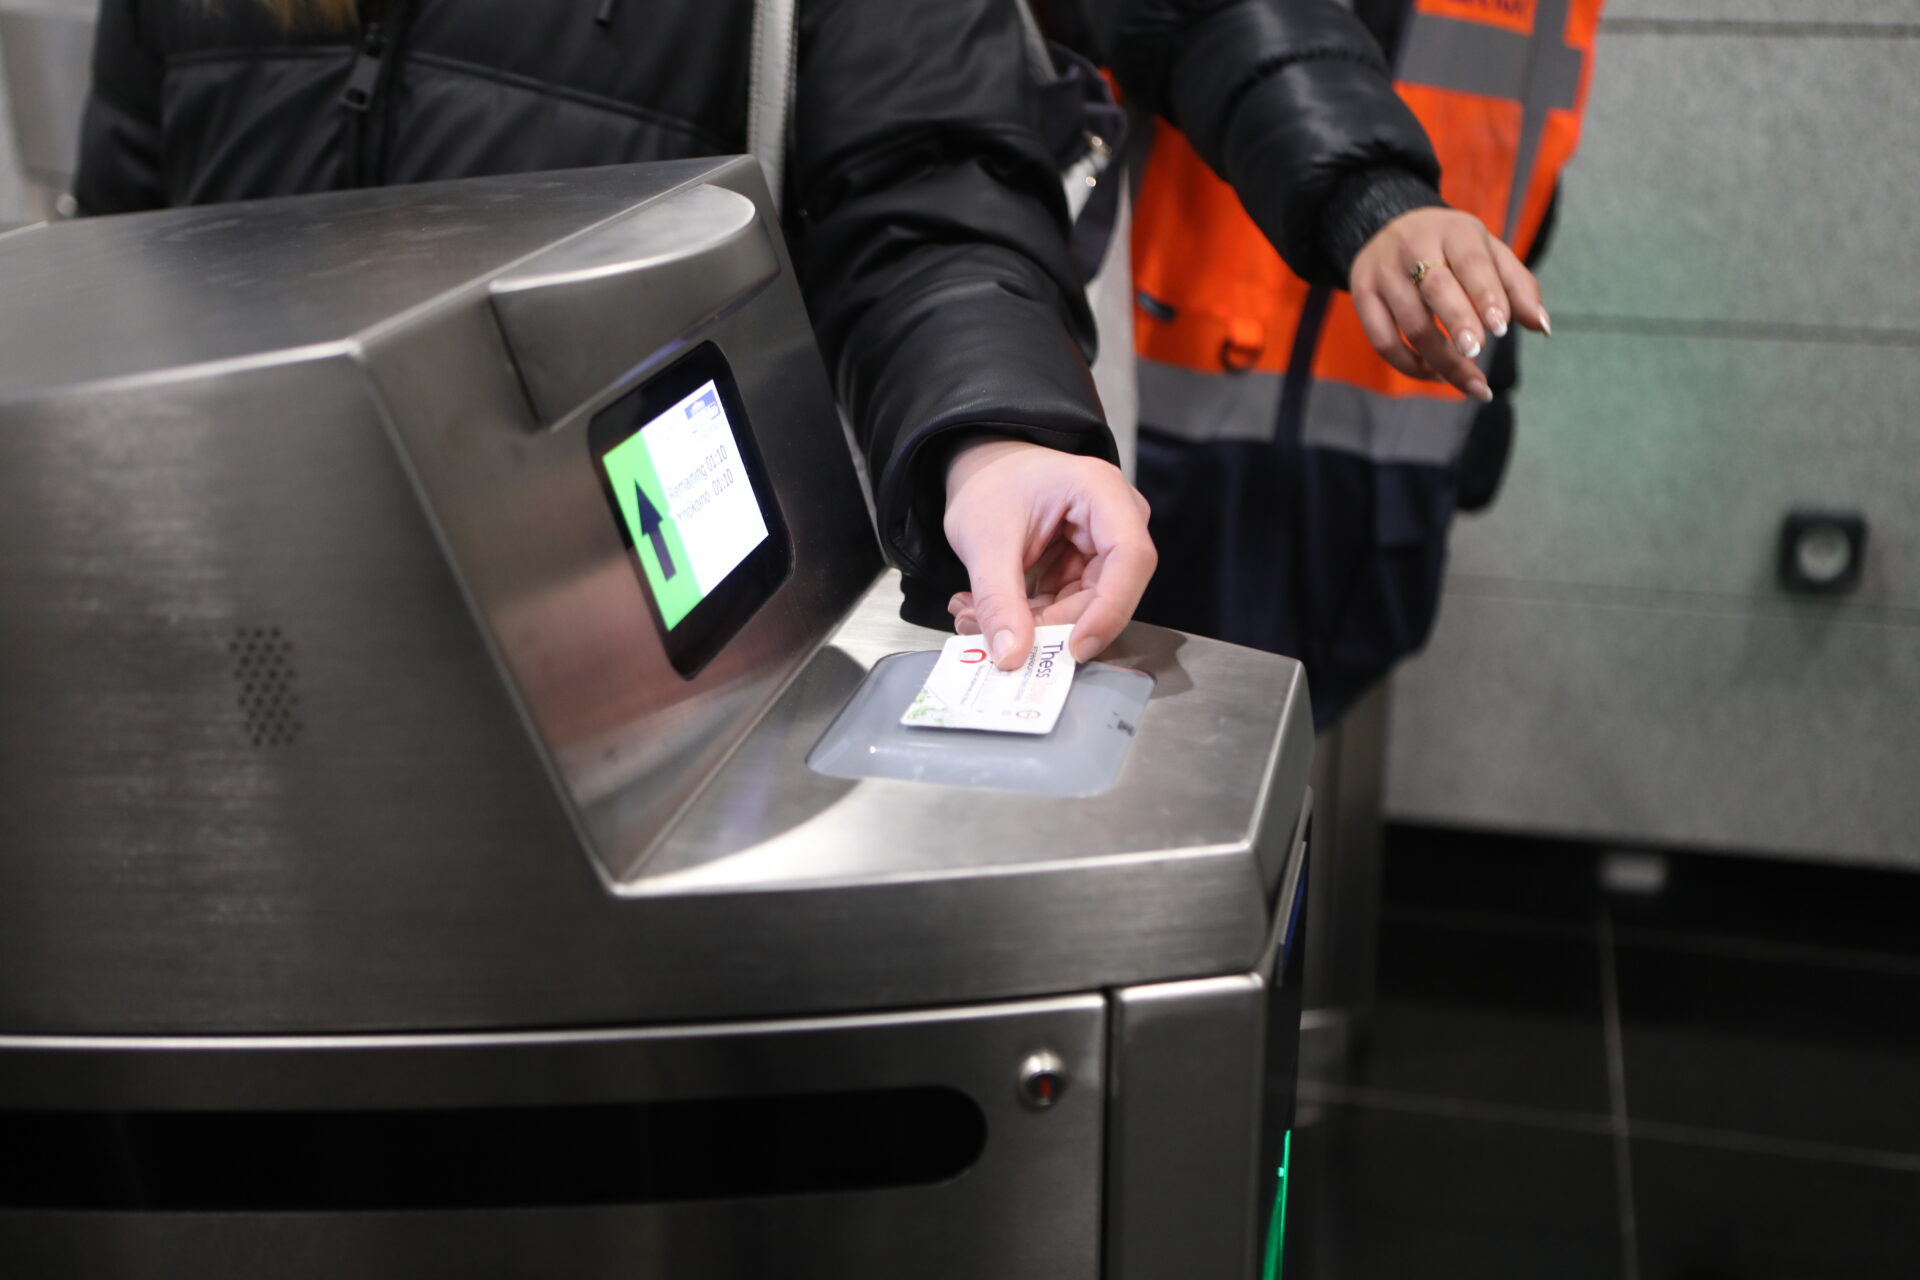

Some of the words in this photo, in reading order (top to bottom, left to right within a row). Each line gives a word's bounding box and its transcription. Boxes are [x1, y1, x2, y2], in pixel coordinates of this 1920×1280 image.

[668, 464, 708, 500] Remaining
[705, 444, 728, 472] 01:10
[711, 468, 734, 496] 01:10
